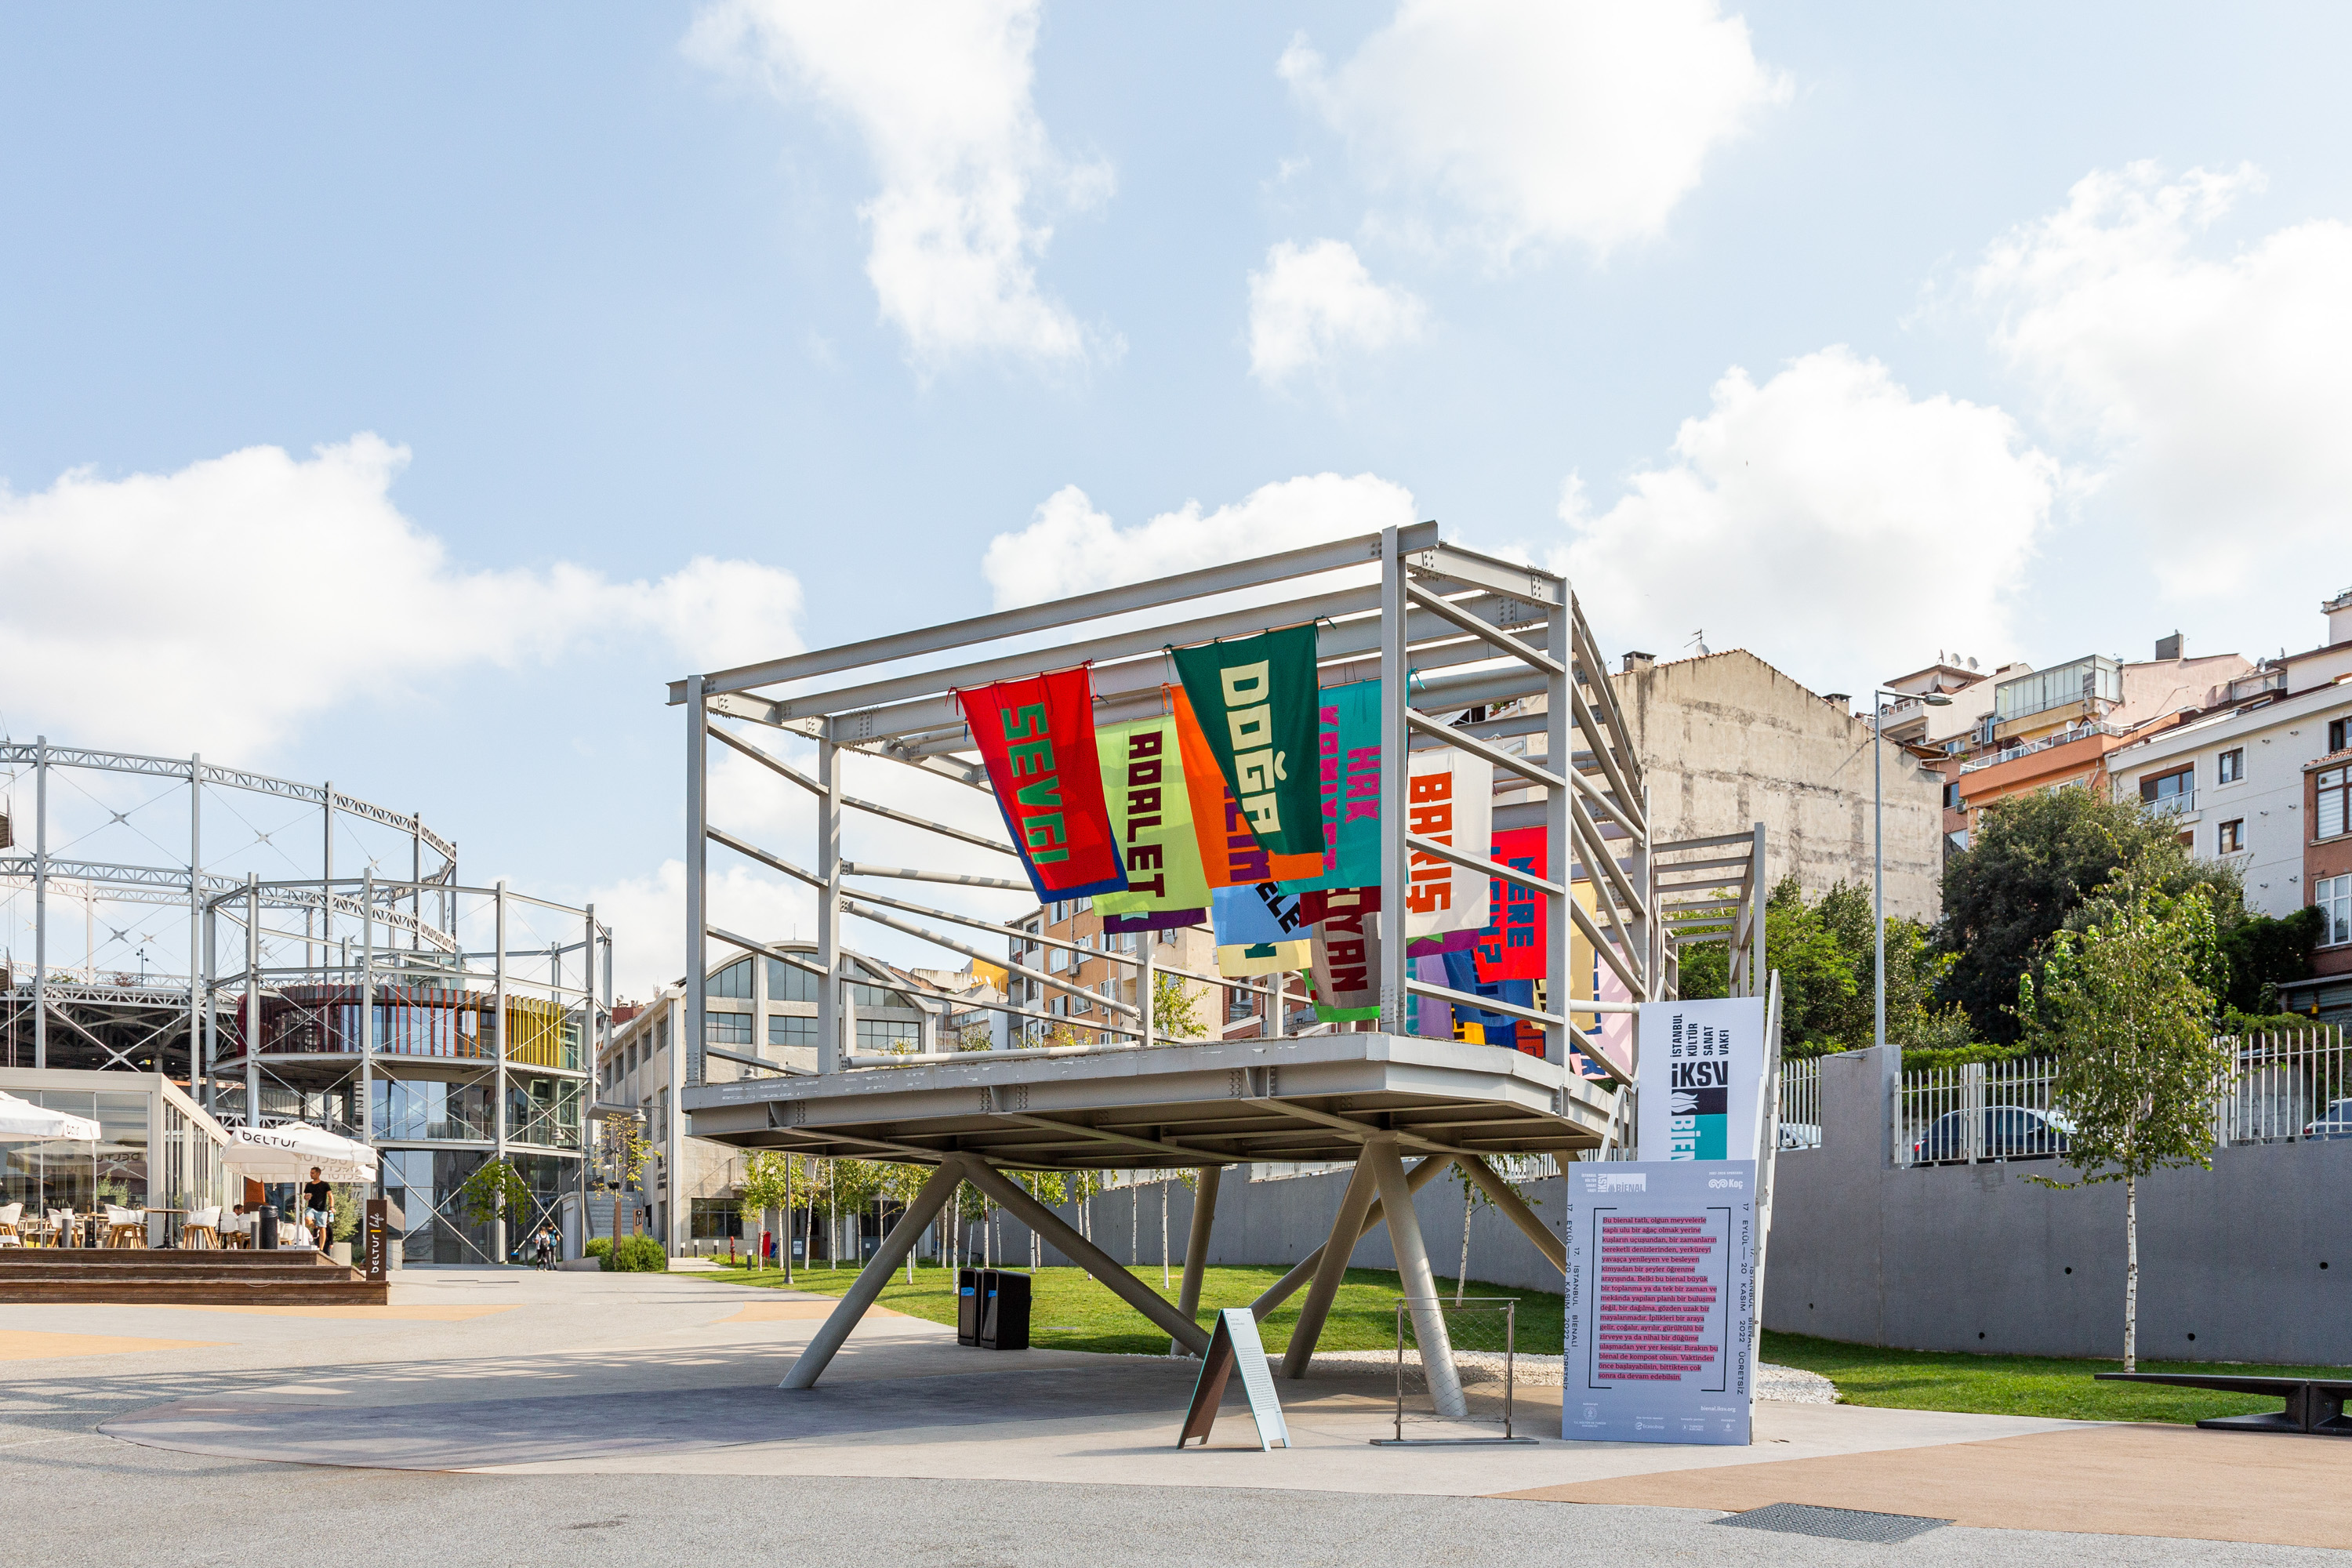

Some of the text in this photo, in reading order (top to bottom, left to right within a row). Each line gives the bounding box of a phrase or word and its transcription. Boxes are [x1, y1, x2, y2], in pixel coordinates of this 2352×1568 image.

[1220, 659, 1287, 834] DOĞA
[1345, 745, 1381, 824] HAK
[1127, 731, 1166, 898] ADALET
[1670, 1013, 1682, 1058] İSTANBUL
[1686, 1023, 1698, 1057] KÜLTÜR
[1703, 1025, 1713, 1056] SANAT
[1719, 1029, 1729, 1055] VAKFI
[1616, 1181, 1644, 1192] BİENAL
[1729, 1178, 1744, 1189] Koç
[1743, 1203, 1749, 1211] 17
[1565, 1261, 1571, 1273] 20
[1740, 1263, 1748, 1274] 20
[1572, 1265, 1581, 1306] İSTANBUL
[1737, 1351, 1746, 1396] ÜCRETSİZ
